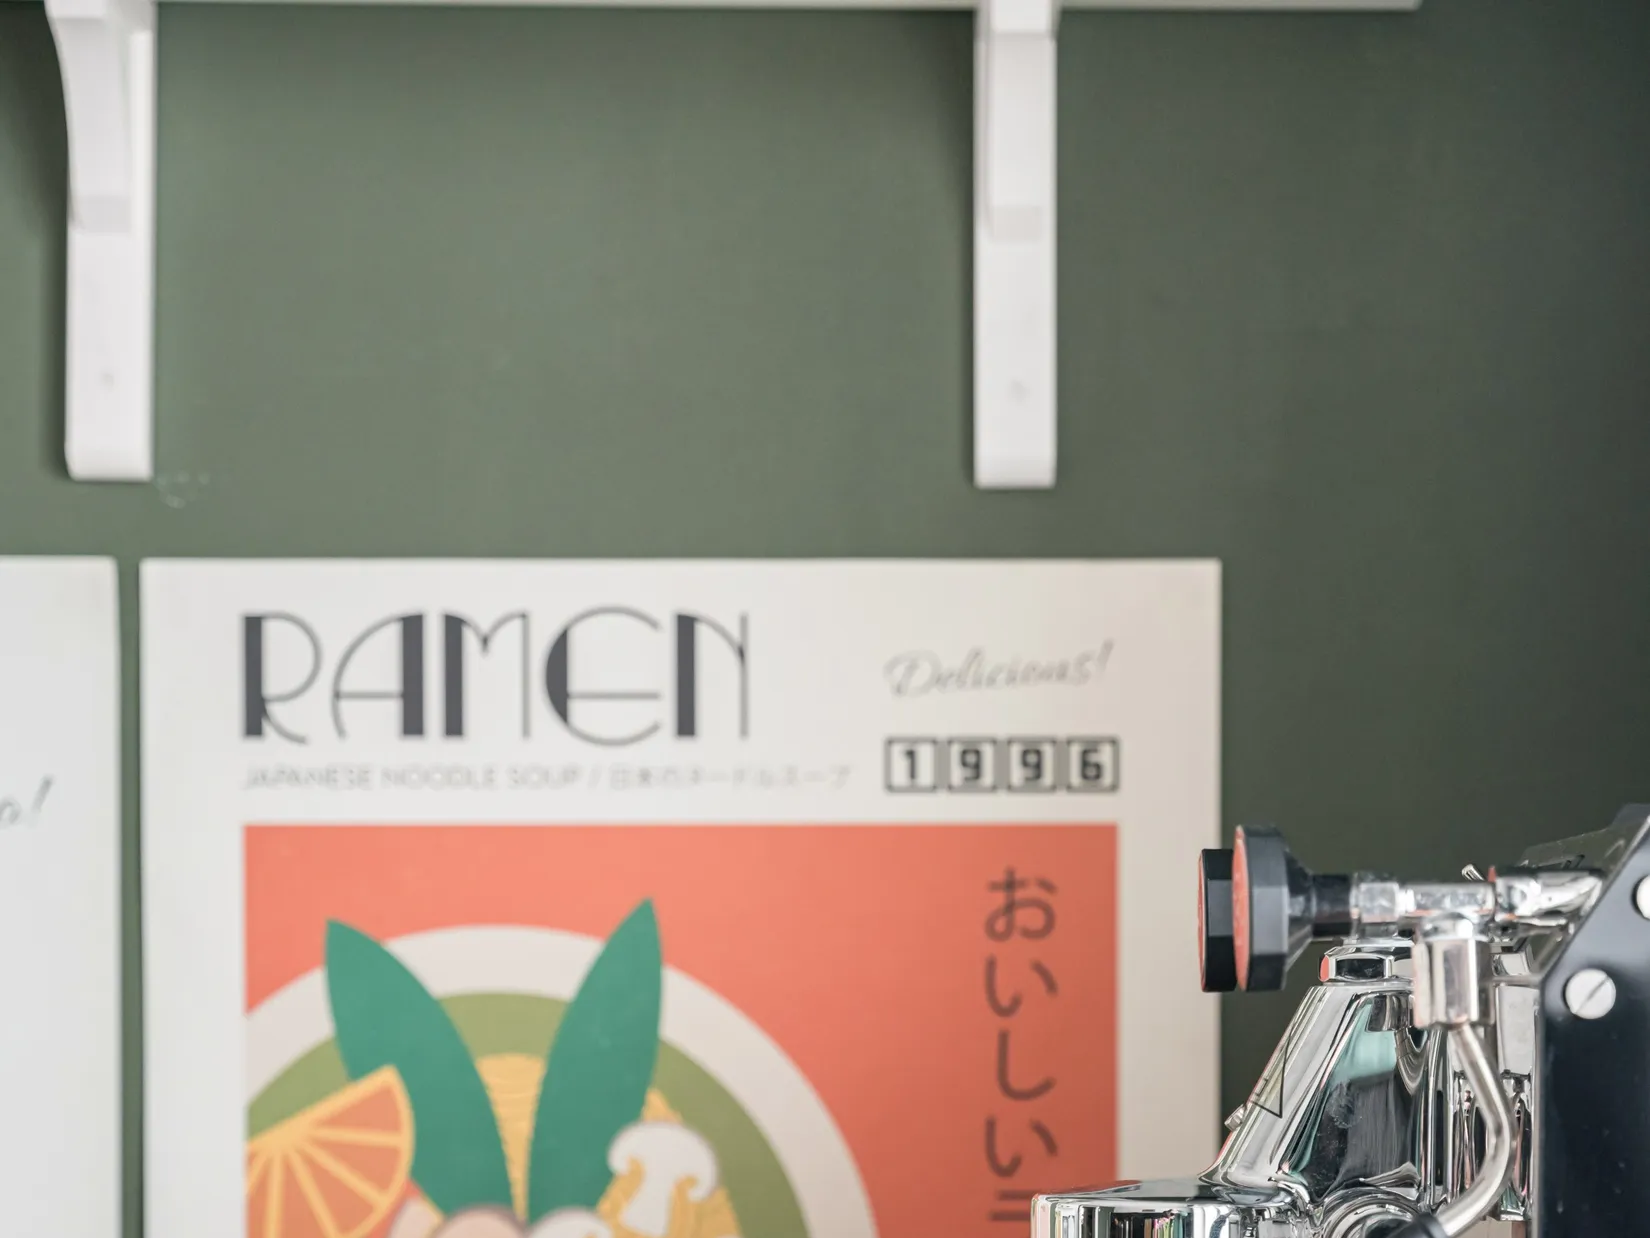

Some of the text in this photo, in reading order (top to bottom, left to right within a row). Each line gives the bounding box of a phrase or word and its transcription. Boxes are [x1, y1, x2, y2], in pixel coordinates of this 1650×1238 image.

[241, 606, 748, 747] RAMEN
[883, 638, 1115, 699] Delicious!
[242, 763, 374, 792] JAPANESE
[380, 763, 499, 791] NOODLE
[505, 763, 582, 790] SOUP
[897, 745, 1107, 785] 1996
